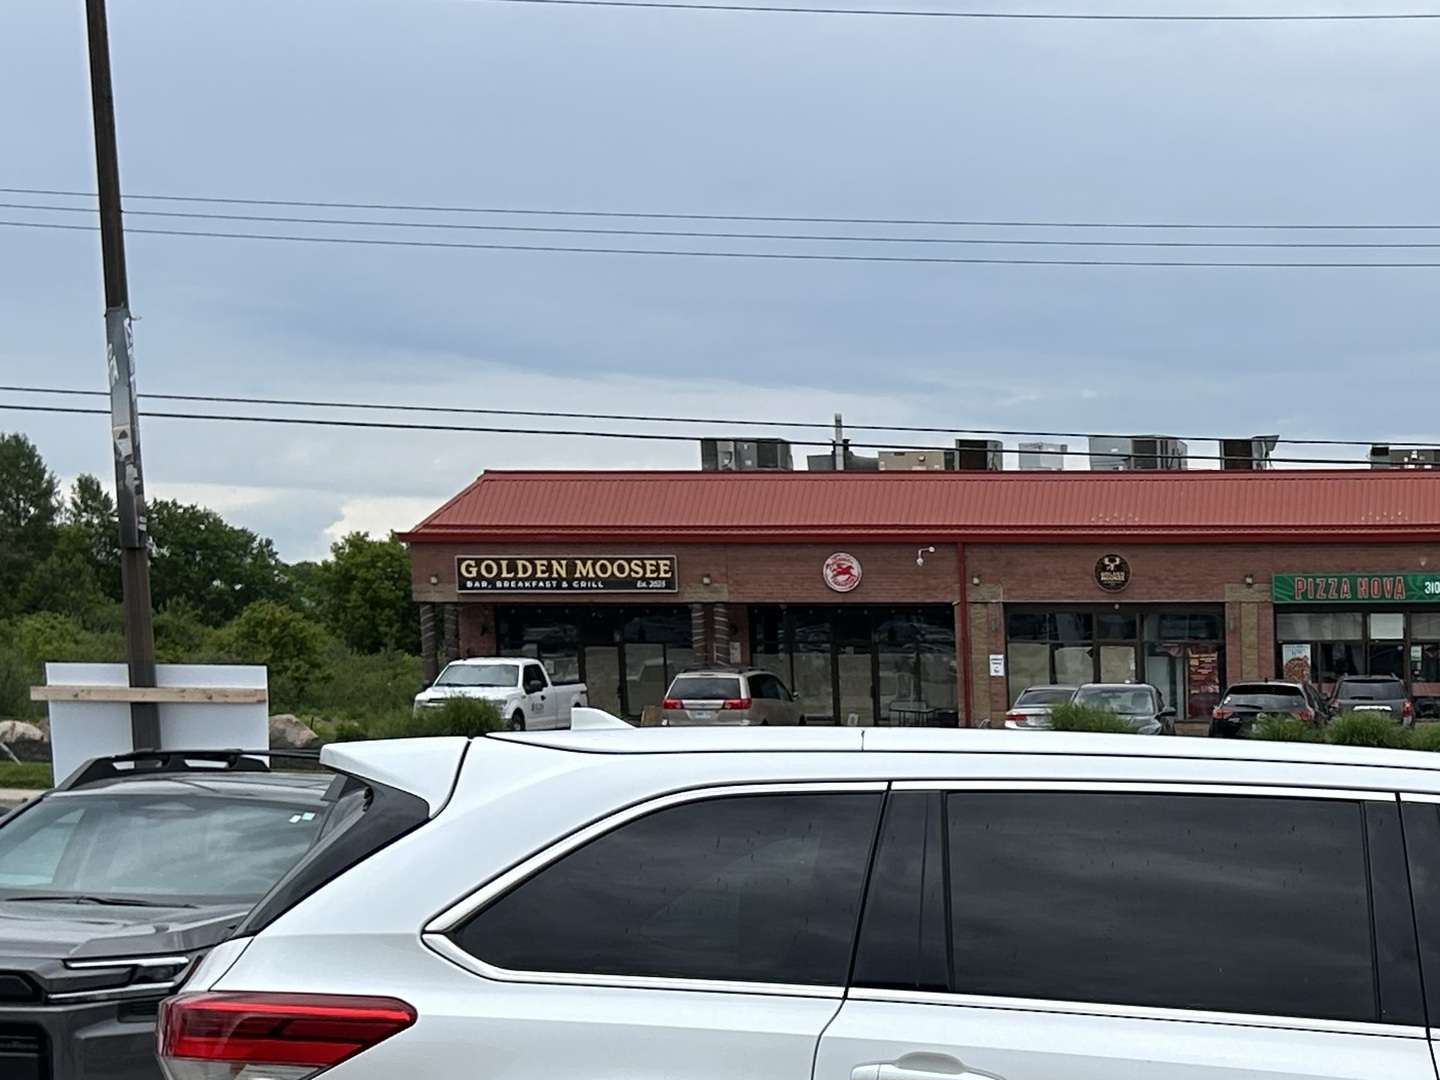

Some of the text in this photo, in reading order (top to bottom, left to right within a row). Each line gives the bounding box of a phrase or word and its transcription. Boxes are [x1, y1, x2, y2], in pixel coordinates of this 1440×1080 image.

[460, 560, 672, 578] GOLDEN MOOSEE
[496, 580, 557, 588] BREAKFAST
[572, 580, 604, 588] GRILL
[1295, 577, 1351, 600] PIZZA
[1356, 576, 1406, 599] NOVA
